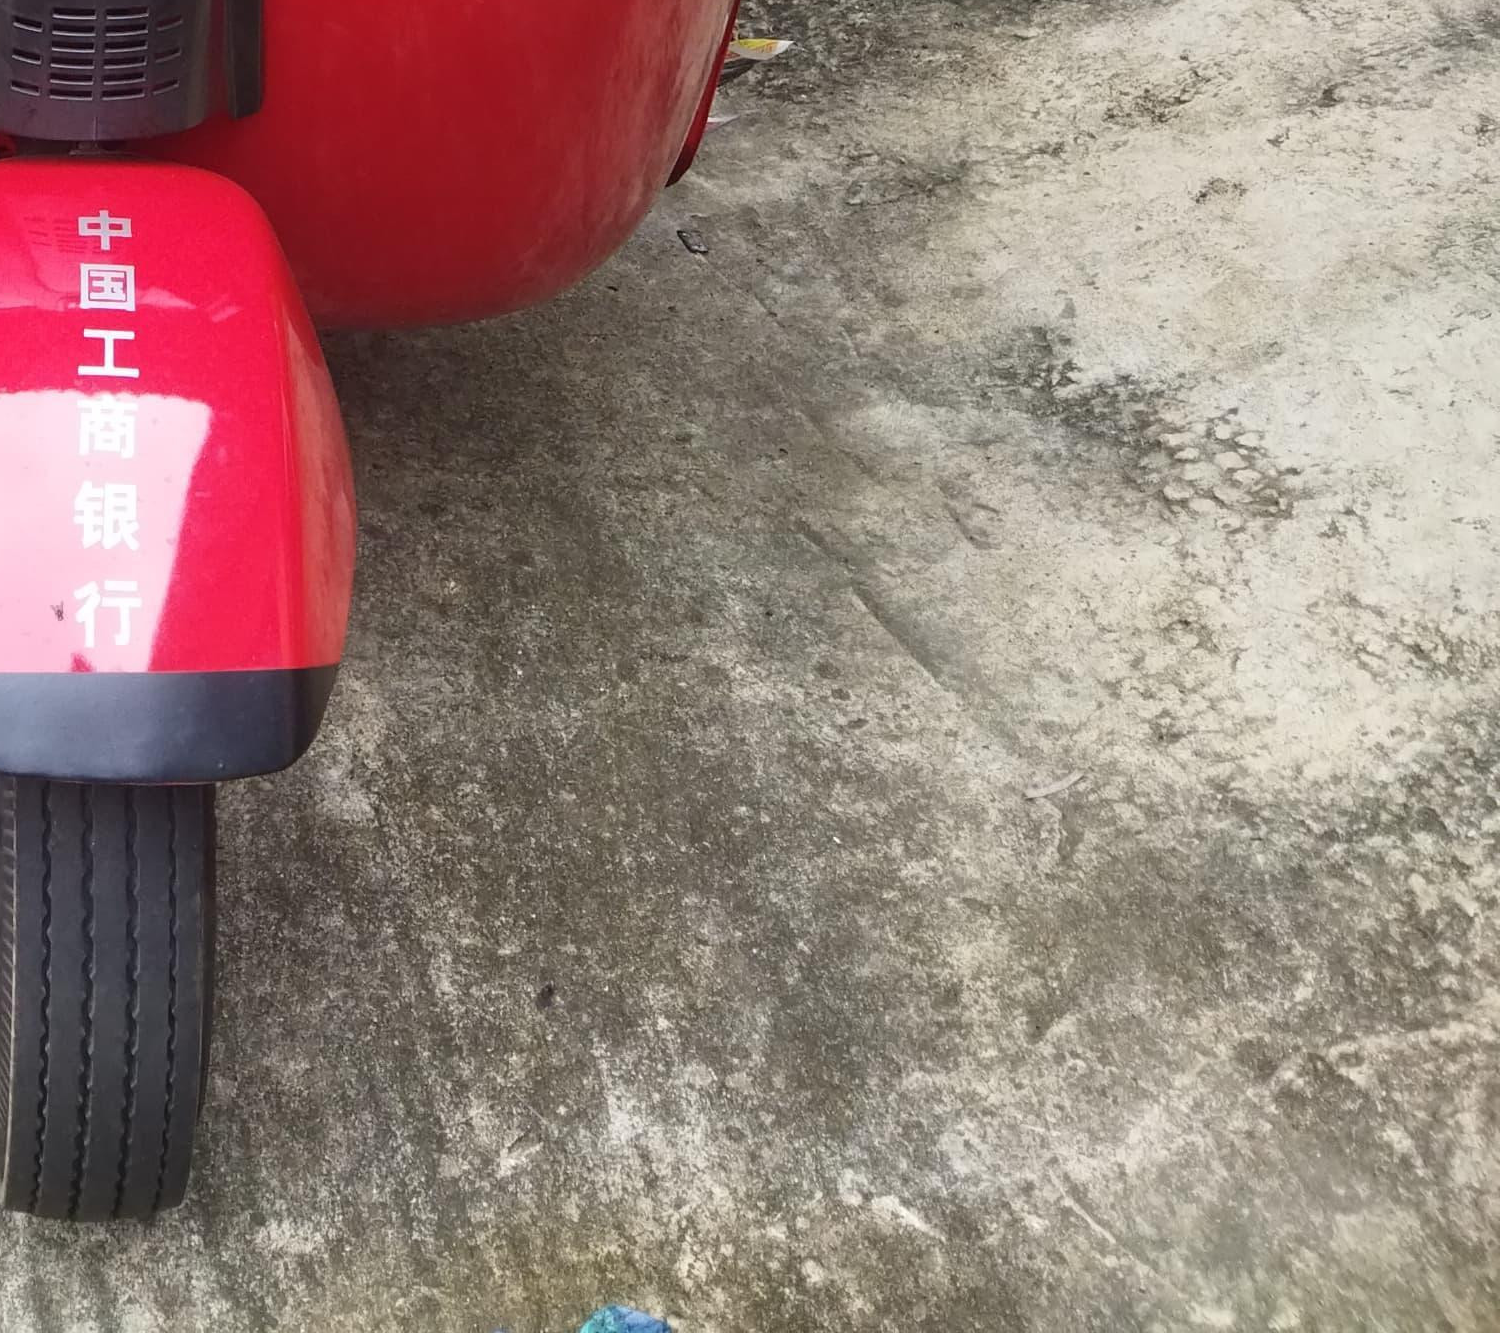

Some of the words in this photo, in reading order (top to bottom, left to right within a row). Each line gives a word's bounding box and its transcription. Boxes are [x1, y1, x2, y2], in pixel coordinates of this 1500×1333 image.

[73, 209, 142, 648] 中国工商银行
